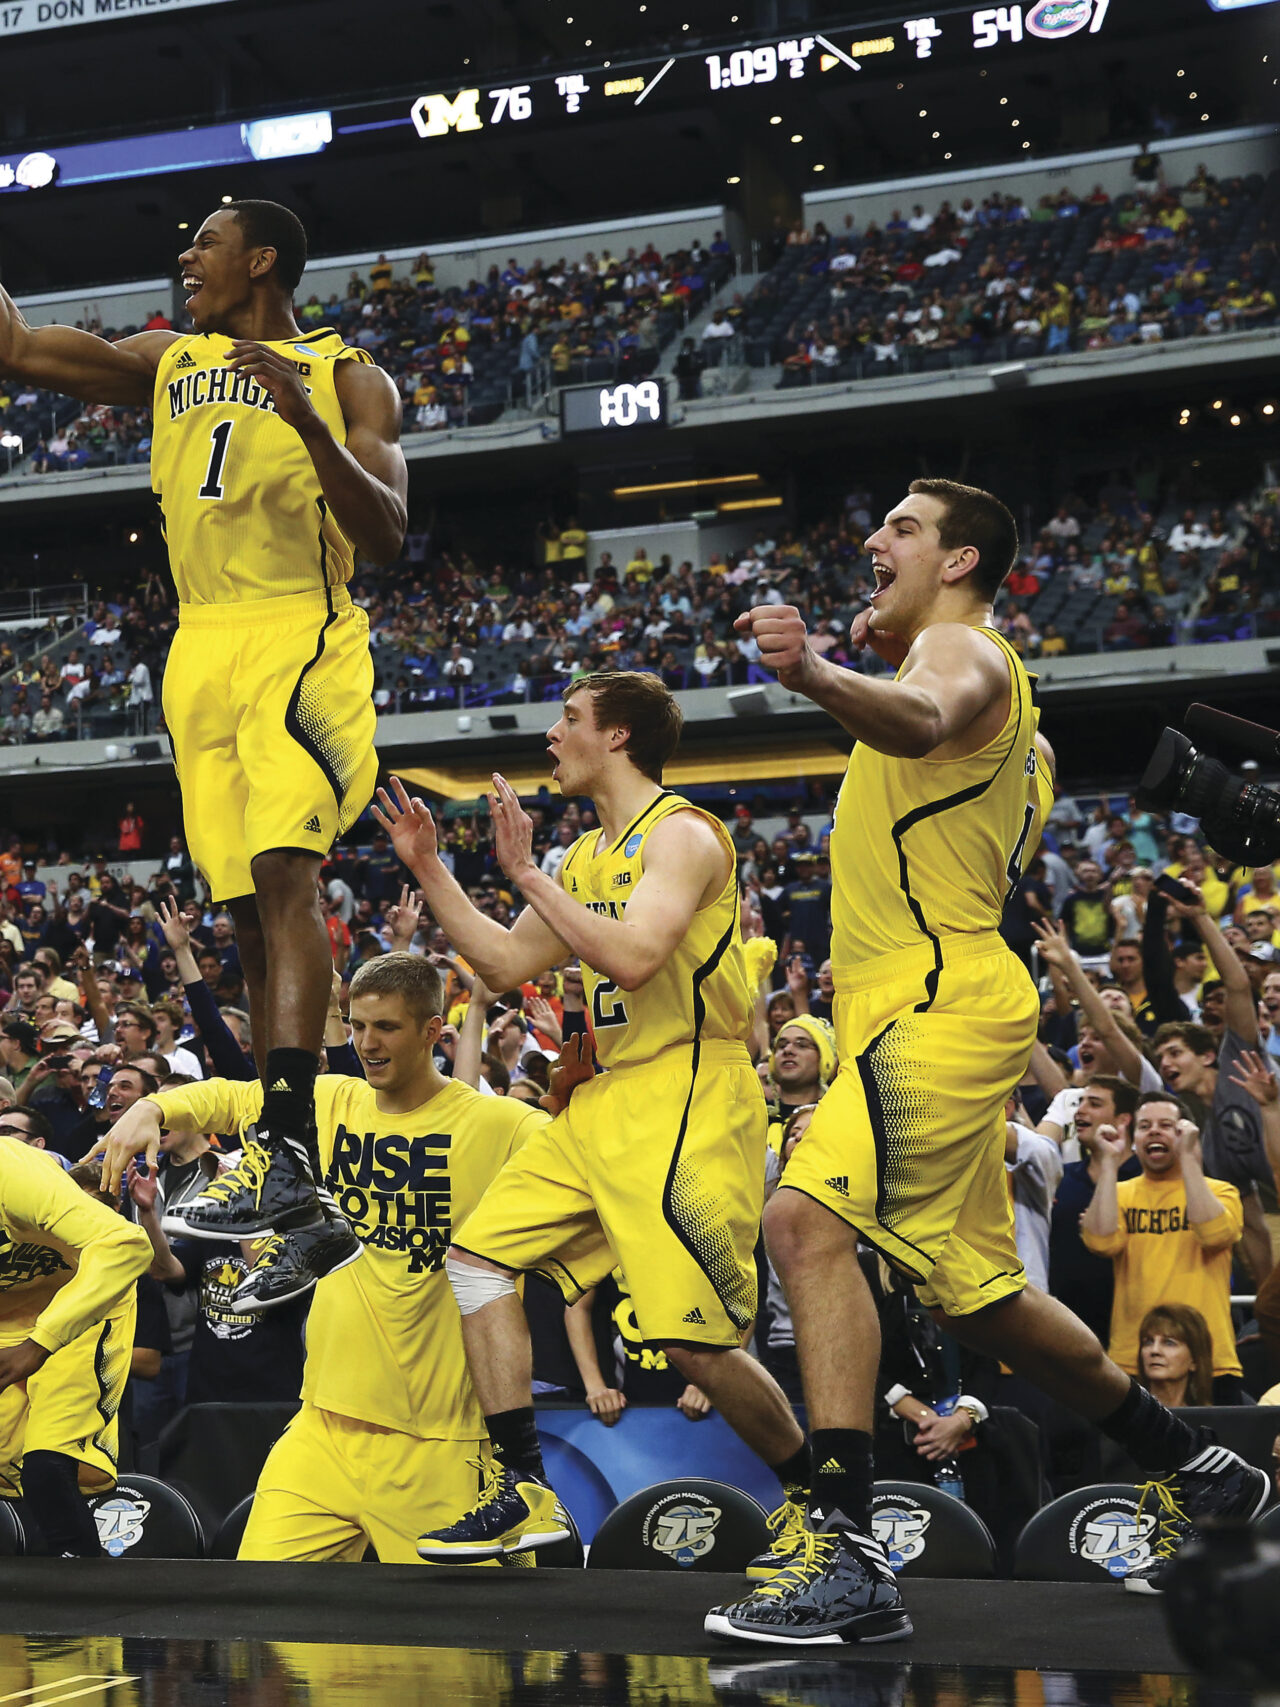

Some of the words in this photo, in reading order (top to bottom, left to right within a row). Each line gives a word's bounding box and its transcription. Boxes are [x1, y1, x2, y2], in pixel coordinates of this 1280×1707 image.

[2, 8, 23, 28] 17
[37, 1, 95, 23] DON
[972, 4, 1023, 48] 54
[916, 38, 932, 58] 2
[705, 46, 777, 90] 1:09
[789, 58, 804, 79] 2
[489, 85, 532, 124] 76
[566, 94, 580, 113] 2
[197, 420, 237, 500] 1
[592, 976, 633, 1028] 2
[331, 1123, 452, 1192] RISE
[824, 1179, 850, 1197] adidas
[370, 1191, 452, 1227] THE
[638, 1348, 668, 1370] M
[642, 1504, 660, 1546] CELEBRATING
[657, 1492, 681, 1507] MARCH
[681, 1492, 713, 1505] MADNESS
[872, 1495, 887, 1504] RCH
[93, 1508, 144, 1547] 75
[657, 1515, 716, 1557] 75
[1068, 1510, 1087, 1554] CELEBRATING
[1083, 1499, 1109, 1512] MARCH
[1109, 1498, 1141, 1511] MADNES
[1085, 1521, 1151, 1567] 75
